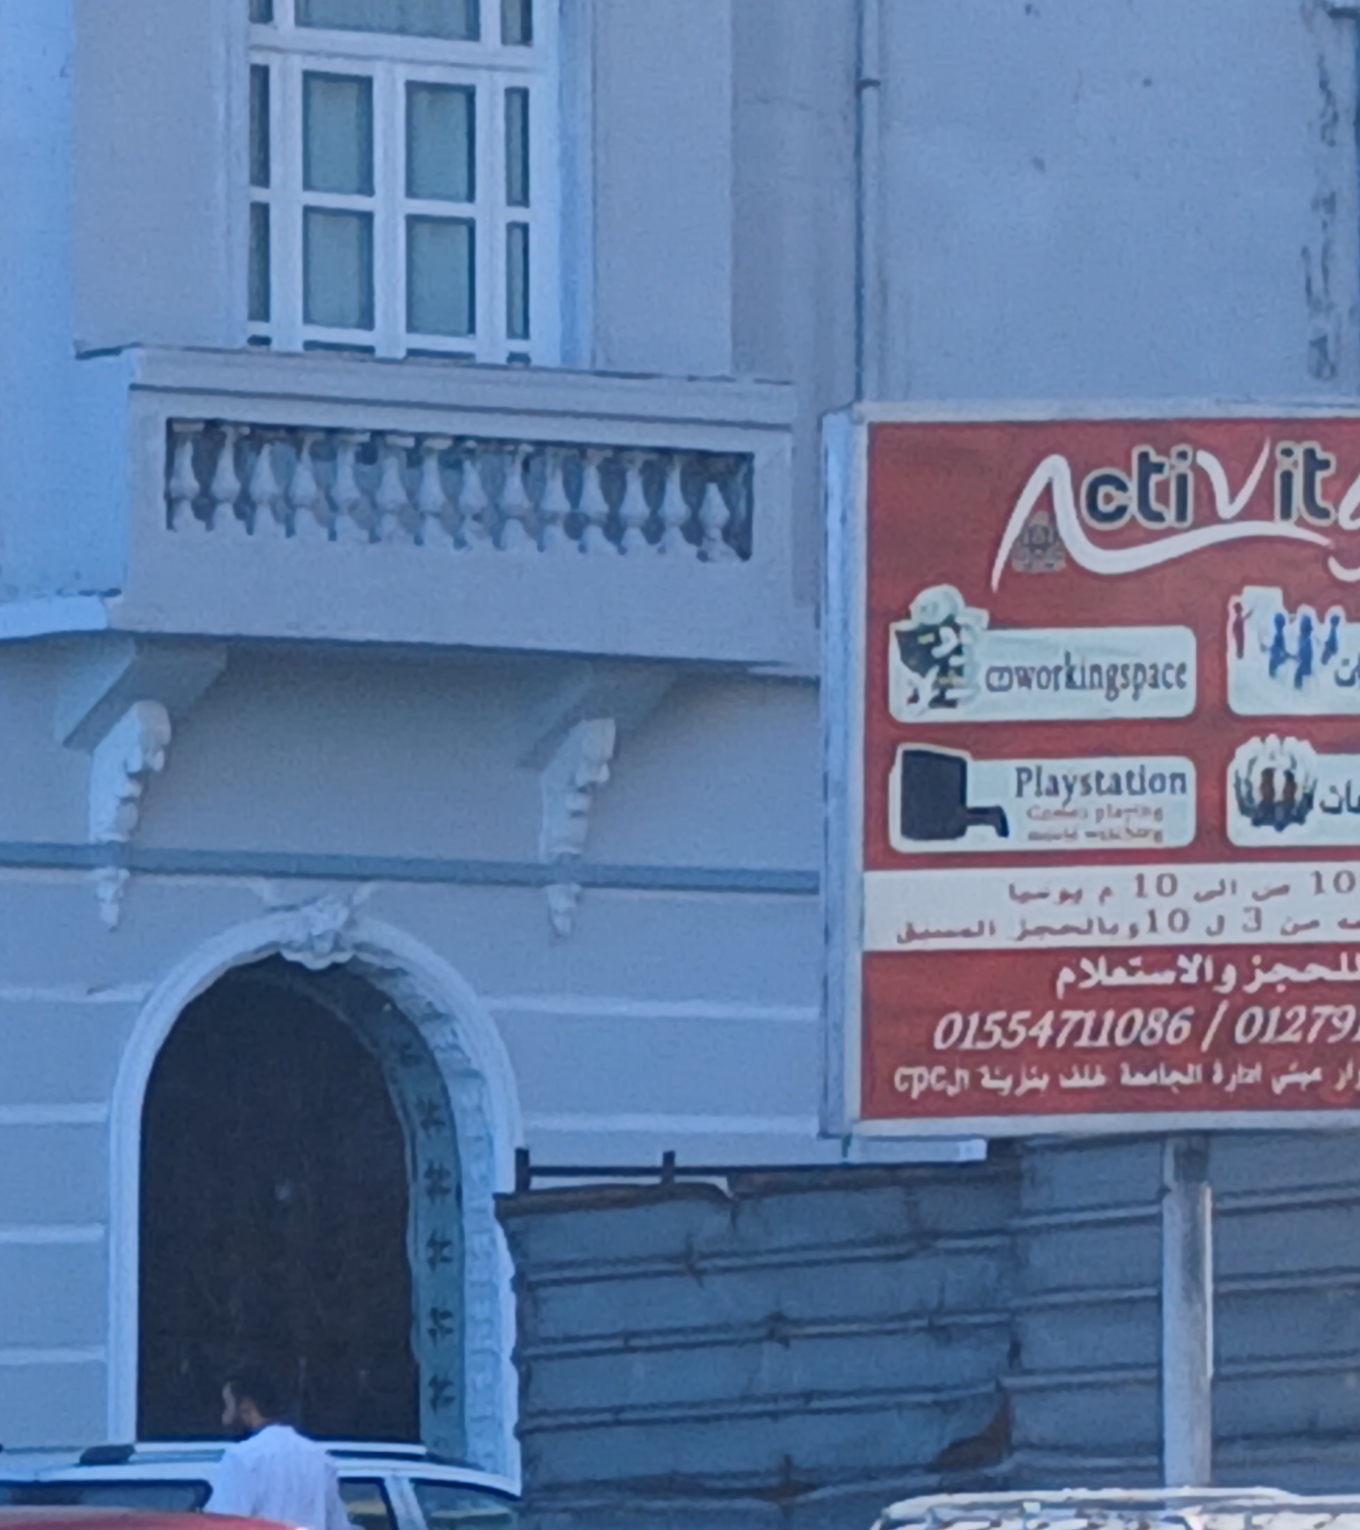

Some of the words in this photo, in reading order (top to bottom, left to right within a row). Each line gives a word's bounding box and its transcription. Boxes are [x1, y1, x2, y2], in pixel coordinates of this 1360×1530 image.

[984, 651, 1188, 701] coworkingspace
[1015, 764, 1188, 808] Playstation
[1135, 872, 1179, 899] 10
[1310, 869, 1357, 896] 10
[1147, 907, 1191, 934] 10
[1241, 906, 1263, 933] 3
[933, 1007, 1194, 1051] 01554711086
